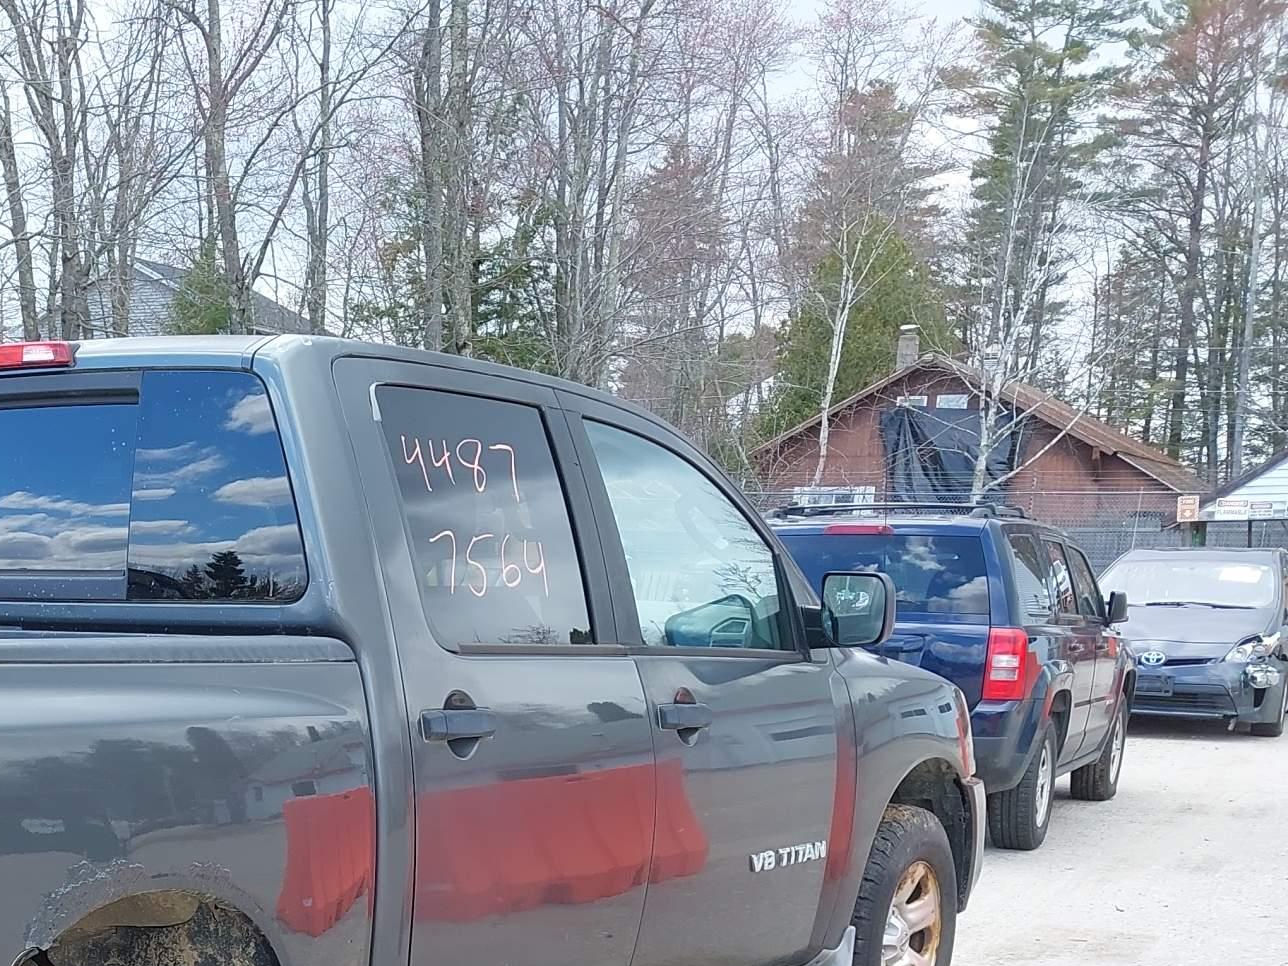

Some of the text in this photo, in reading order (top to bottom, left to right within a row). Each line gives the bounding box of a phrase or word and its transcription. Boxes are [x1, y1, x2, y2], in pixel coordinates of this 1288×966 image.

[400, 434, 520, 503] 4487
[428, 529, 549, 599] 7564
[750, 840, 827, 873] V8 TITAN
